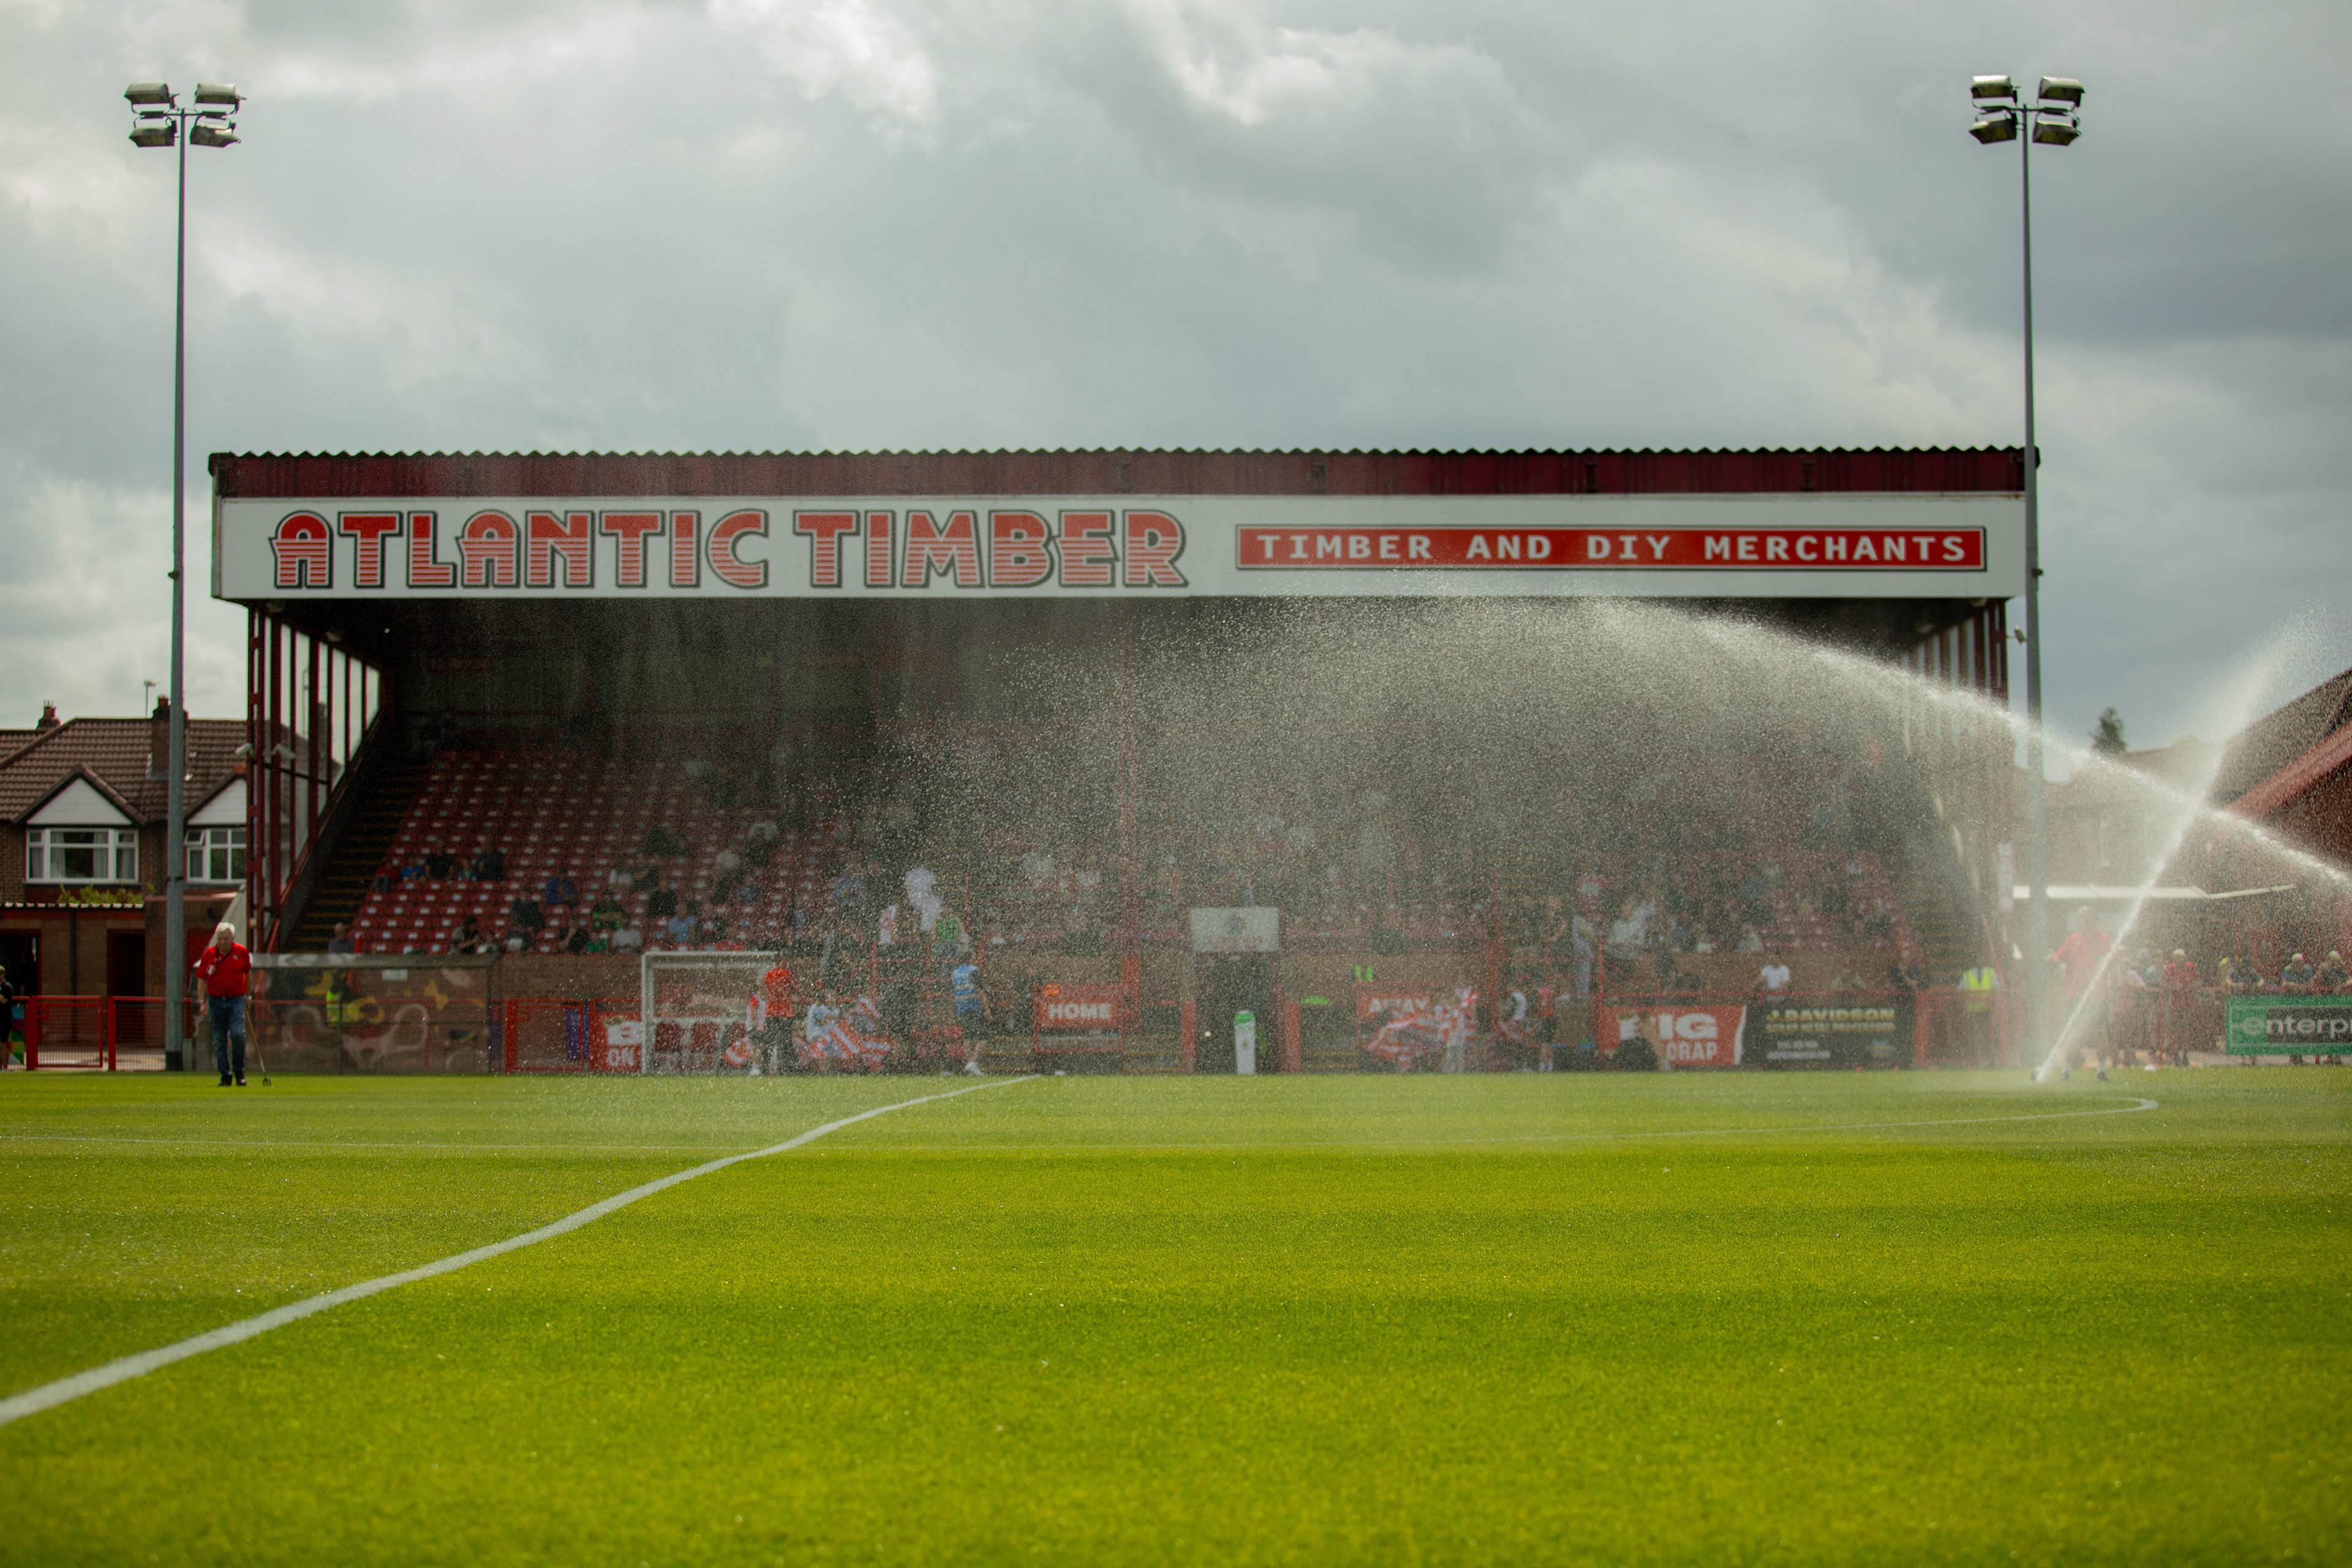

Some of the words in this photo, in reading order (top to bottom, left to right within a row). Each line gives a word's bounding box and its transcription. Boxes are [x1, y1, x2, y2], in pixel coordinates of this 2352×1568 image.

[268, 509, 768, 589] ATLANTIC
[793, 509, 1188, 589] TIMBER
[1257, 534, 1432, 560] TIMBER
[1466, 535, 1552, 560] AND
[1587, 535, 1670, 560] DIY
[1704, 535, 1966, 561] MERCHANTS
[1048, 1003, 1112, 1019] HOME
[2242, 1016, 2352, 1039] enterp
[607, 1047, 635, 1067] ON
[1664, 1041, 1717, 1061] CRAP
